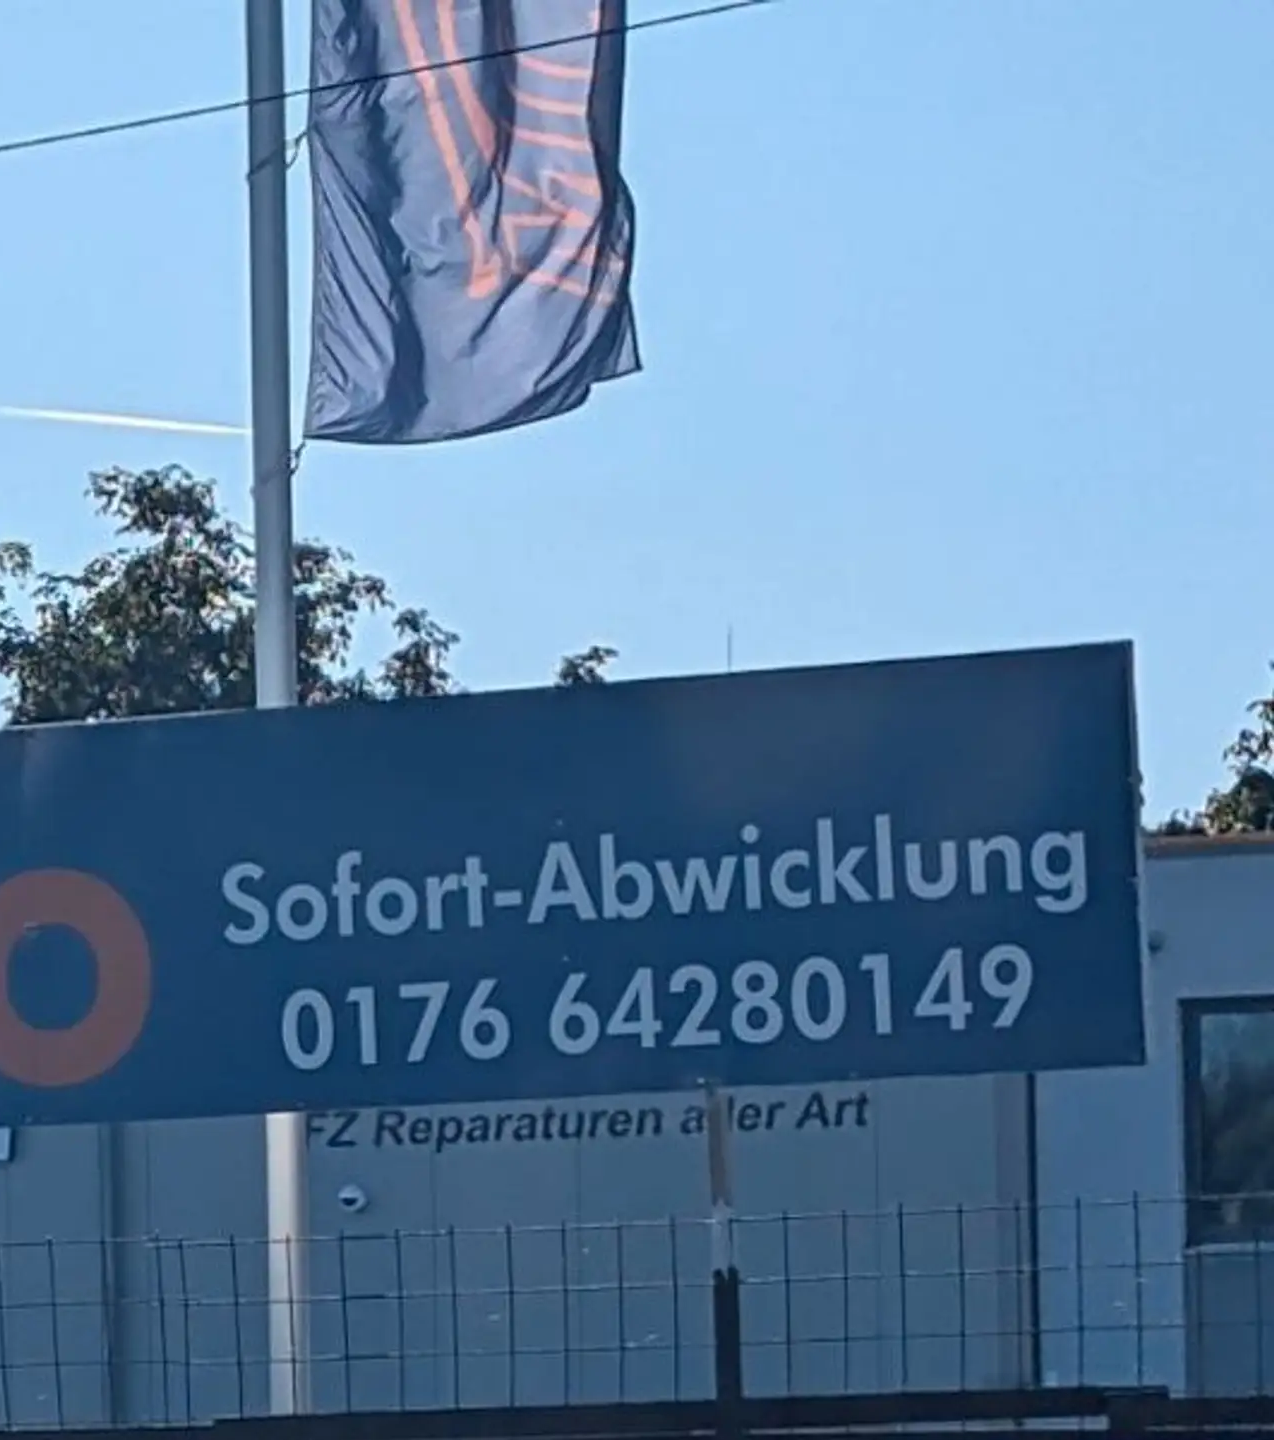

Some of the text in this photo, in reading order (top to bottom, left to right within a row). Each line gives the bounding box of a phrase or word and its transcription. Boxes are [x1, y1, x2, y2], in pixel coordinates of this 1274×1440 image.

[221, 814, 1088, 946] Sofort-Abwicklung
[280, 944, 1034, 1071] 0176 64280149
[306, 1091, 870, 1154] FZ Reparaturen aler Art
